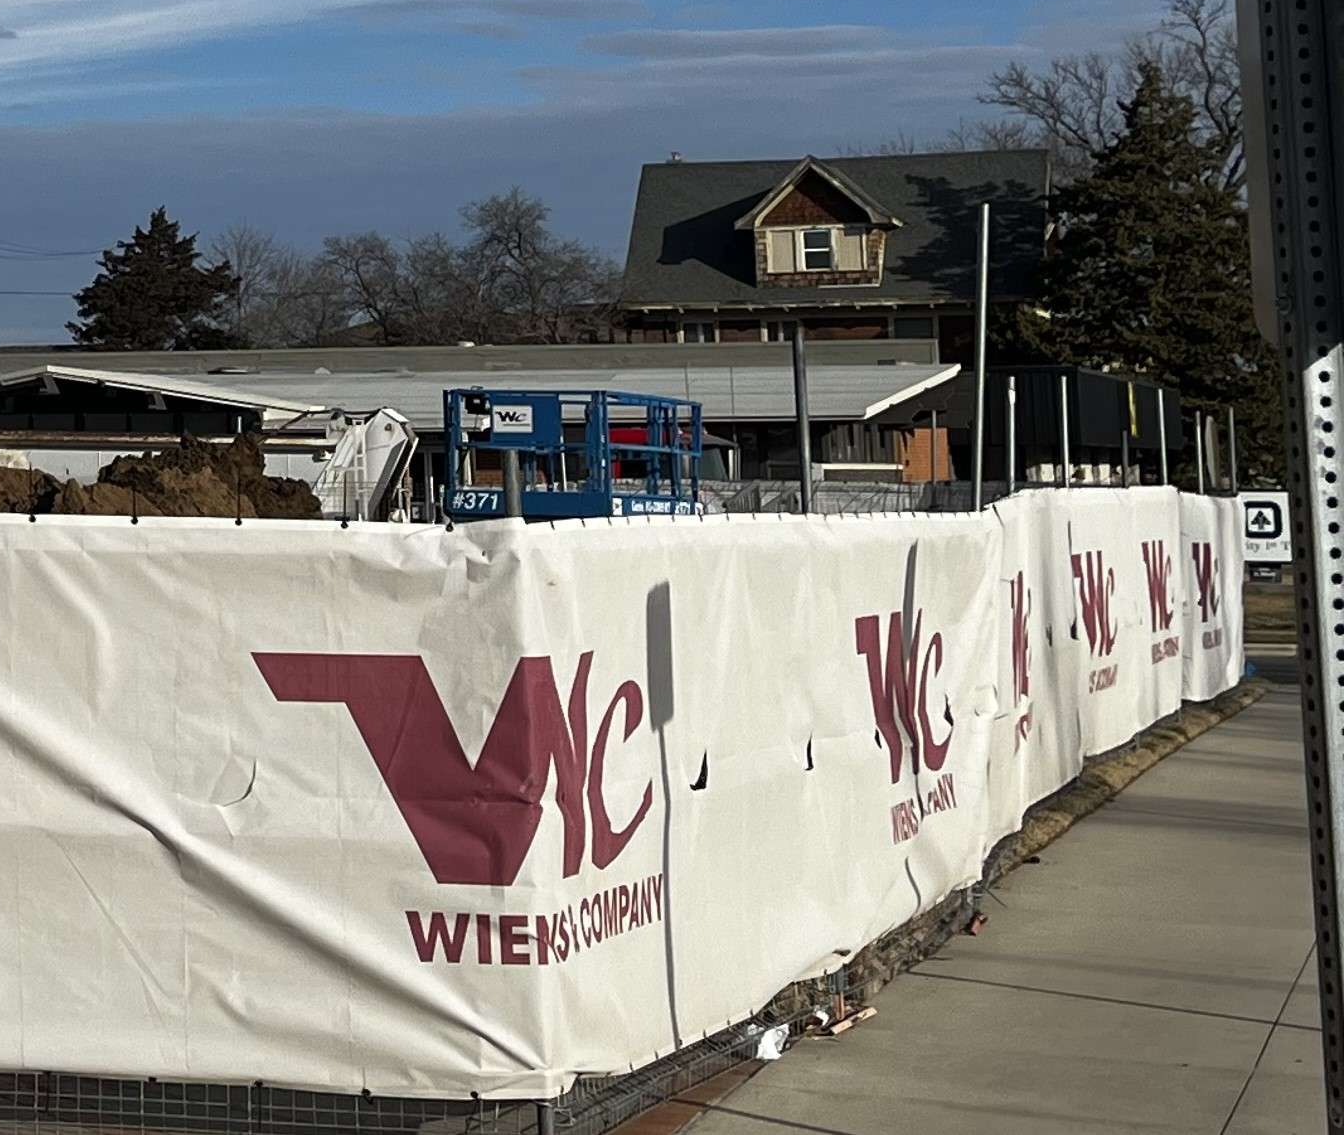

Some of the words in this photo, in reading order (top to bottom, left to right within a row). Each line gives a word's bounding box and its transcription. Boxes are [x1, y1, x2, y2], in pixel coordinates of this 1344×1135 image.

[452, 492, 498, 511] #371
[405, 906, 569, 965] WIENS
[580, 873, 664, 949] COMPANY
